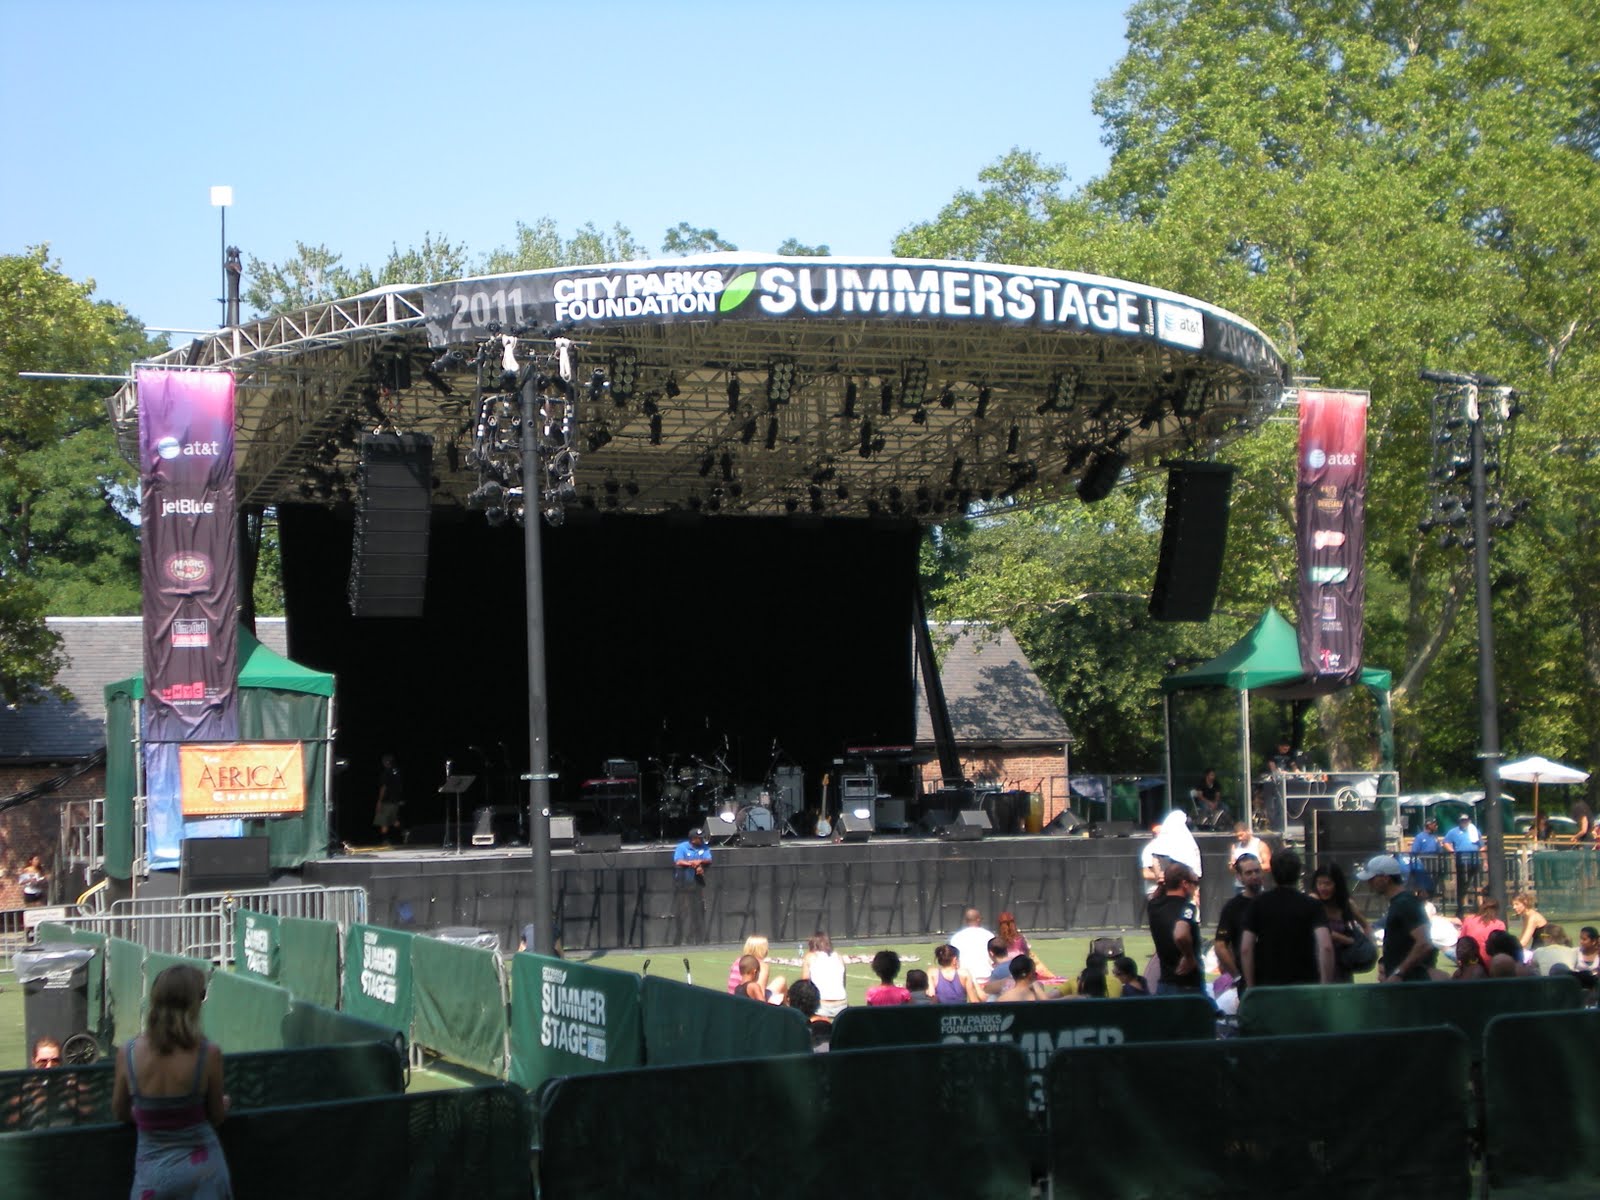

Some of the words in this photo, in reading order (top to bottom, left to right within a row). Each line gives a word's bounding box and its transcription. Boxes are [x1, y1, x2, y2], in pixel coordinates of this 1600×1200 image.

[553, 274, 624, 303] CITY
[625, 270, 724, 297] PARKS
[451, 288, 525, 331] 2011
[555, 292, 716, 322] FOUNDATION
[759, 267, 1141, 334] SUMMERSTAGE
[1179, 317, 1201, 335] at&t
[183, 440, 220, 456] at&t
[1327, 452, 1357, 466] at&t
[161, 498, 215, 517] jetBlue
[198, 764, 286, 788] AFRICA
[541, 982, 606, 1027] SUMMER
[941, 1016, 967, 1027] CITY
[967, 1014, 1002, 1026] PARKS
[941, 1023, 1000, 1034] FOUNDATION
[541, 1014, 588, 1057] STAGE
